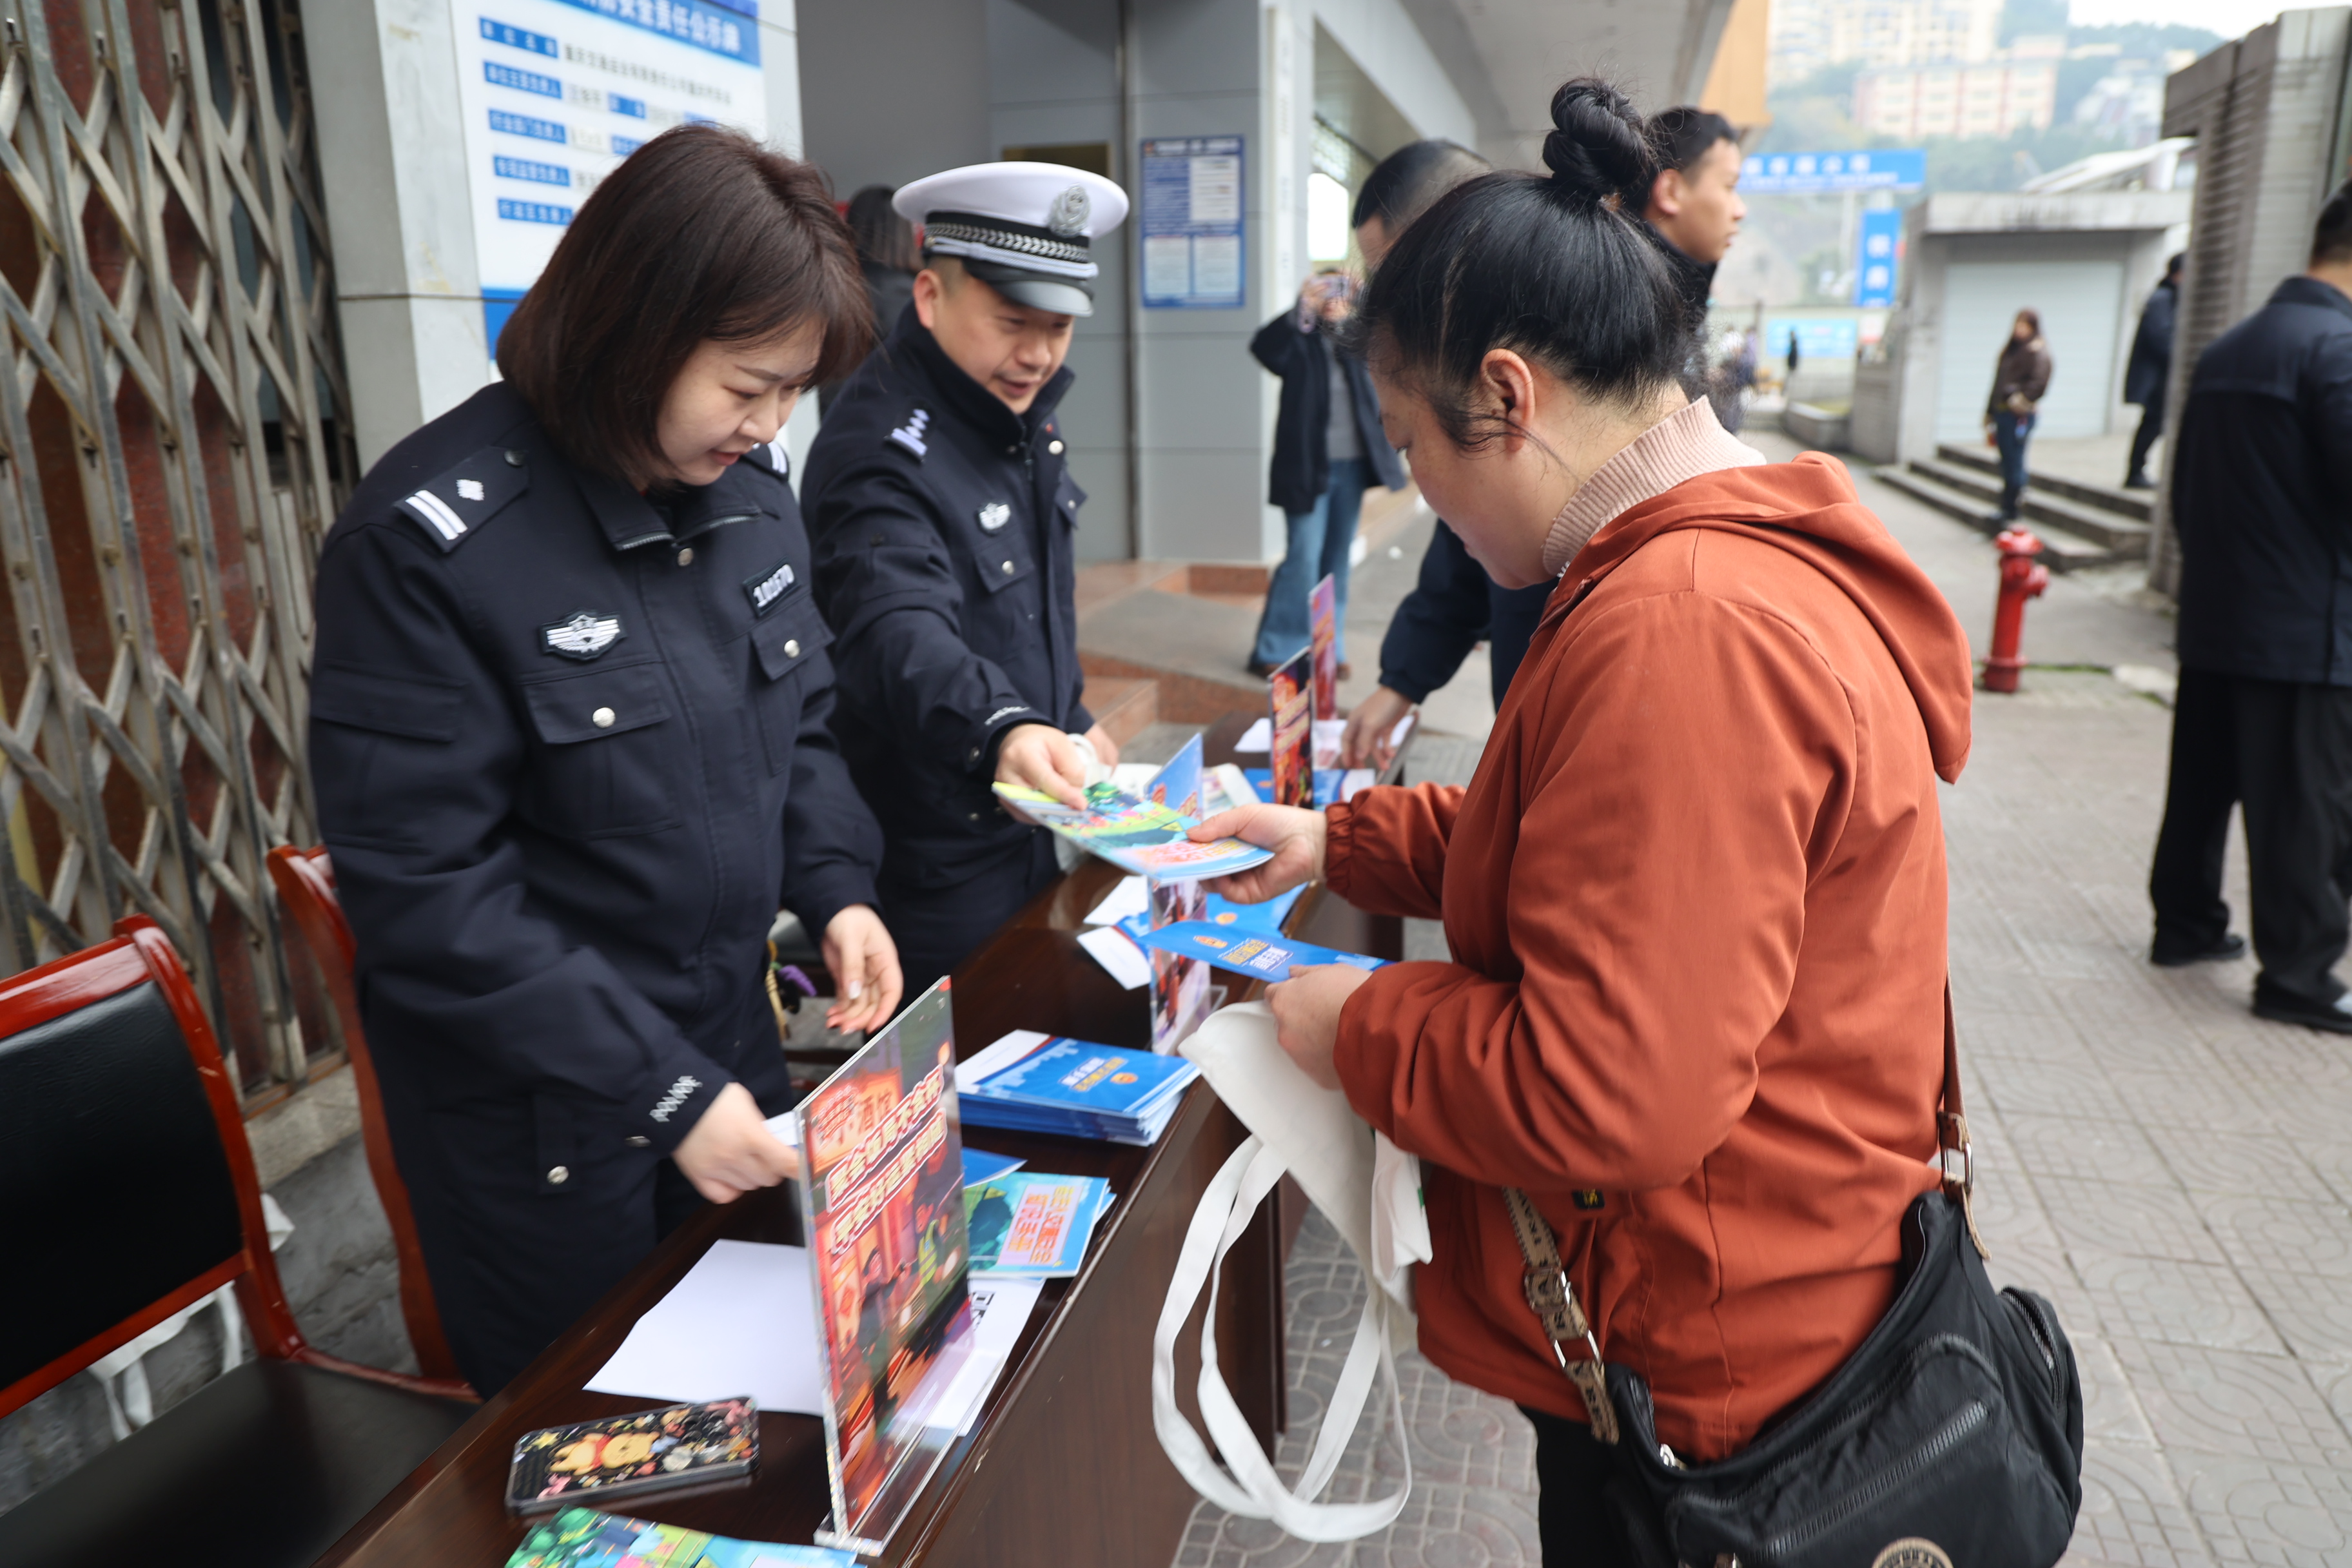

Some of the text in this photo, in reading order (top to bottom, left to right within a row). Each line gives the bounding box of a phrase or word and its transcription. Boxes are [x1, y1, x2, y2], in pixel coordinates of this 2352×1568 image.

[830, 1070, 940, 1203] 聚会饭局不贪杯
[835, 1112, 943, 1253] 平安好运紧相随
